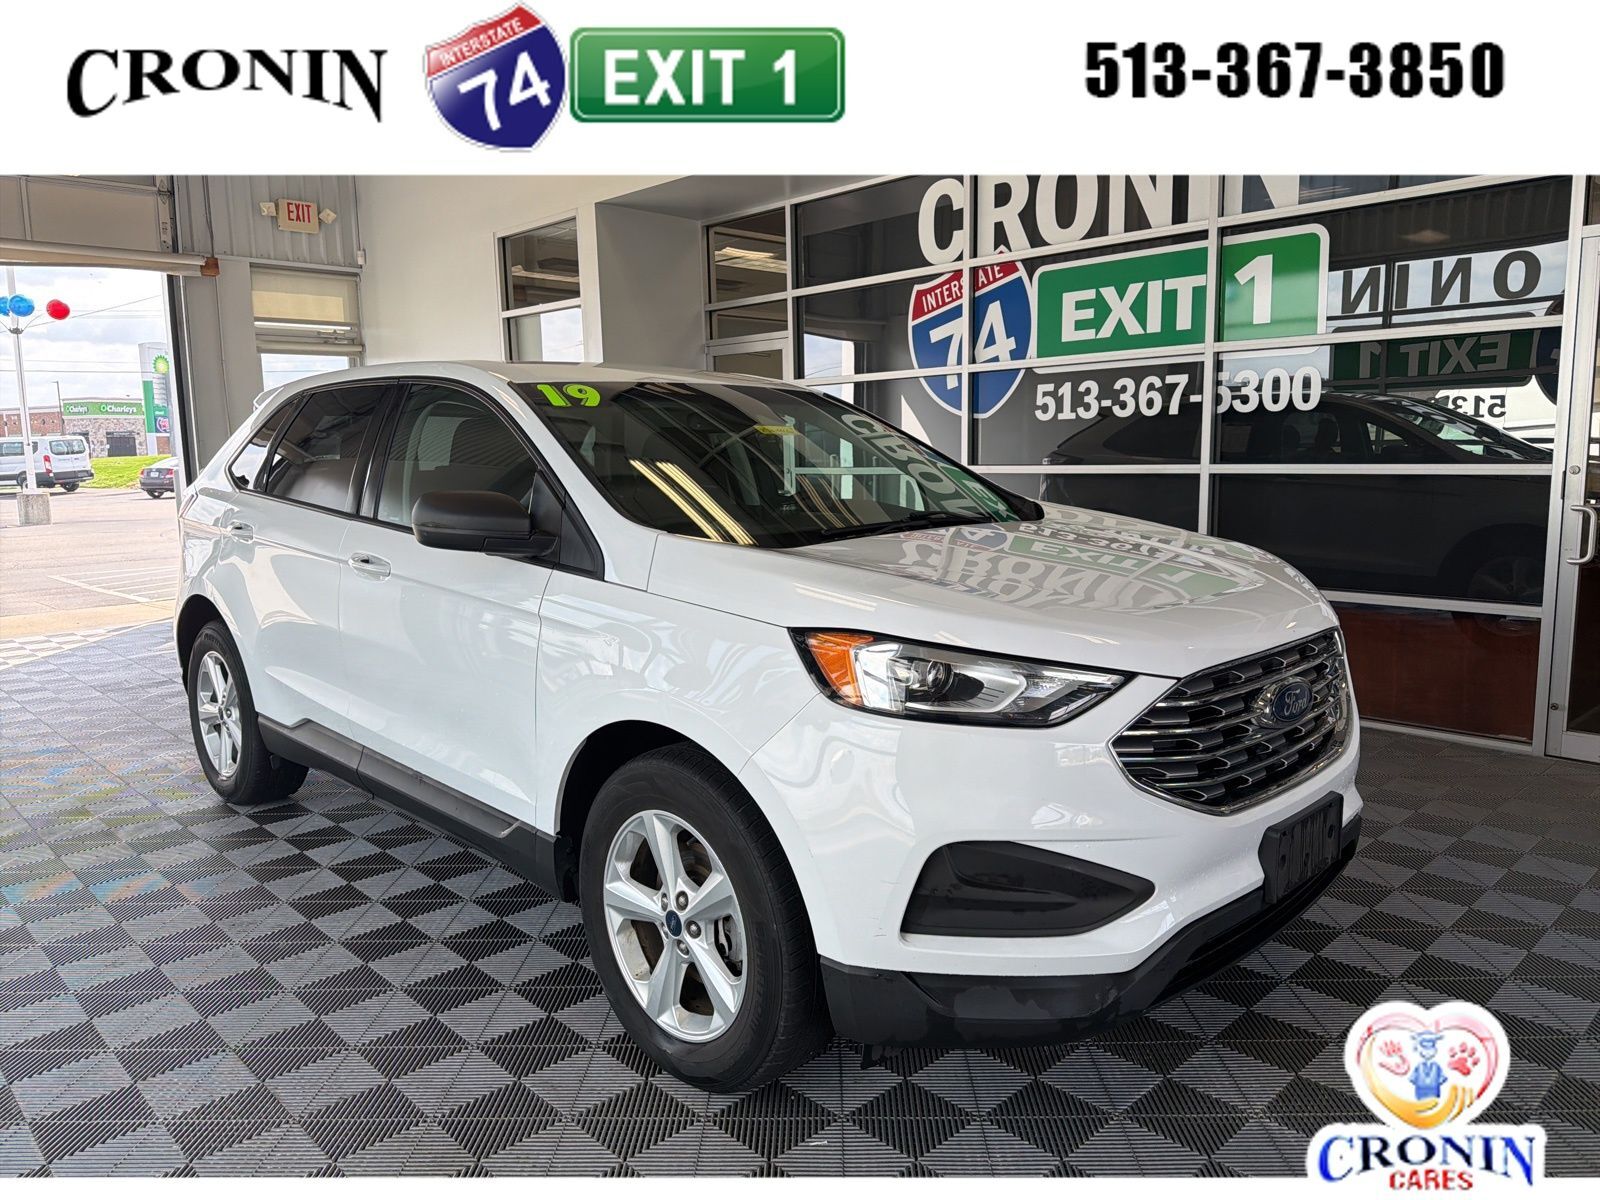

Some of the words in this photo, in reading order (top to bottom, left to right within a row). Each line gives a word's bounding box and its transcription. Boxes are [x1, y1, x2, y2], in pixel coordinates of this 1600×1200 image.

[286, 202, 312, 224] EXIT
[921, 263, 1004, 313] INTERATE
[1061, 274, 1207, 342] EXIT
[1234, 254, 1273, 325] 1
[929, 300, 1017, 390] 74
[536, 383, 601, 407] 19
[1284, 687, 1311, 716] Ford
